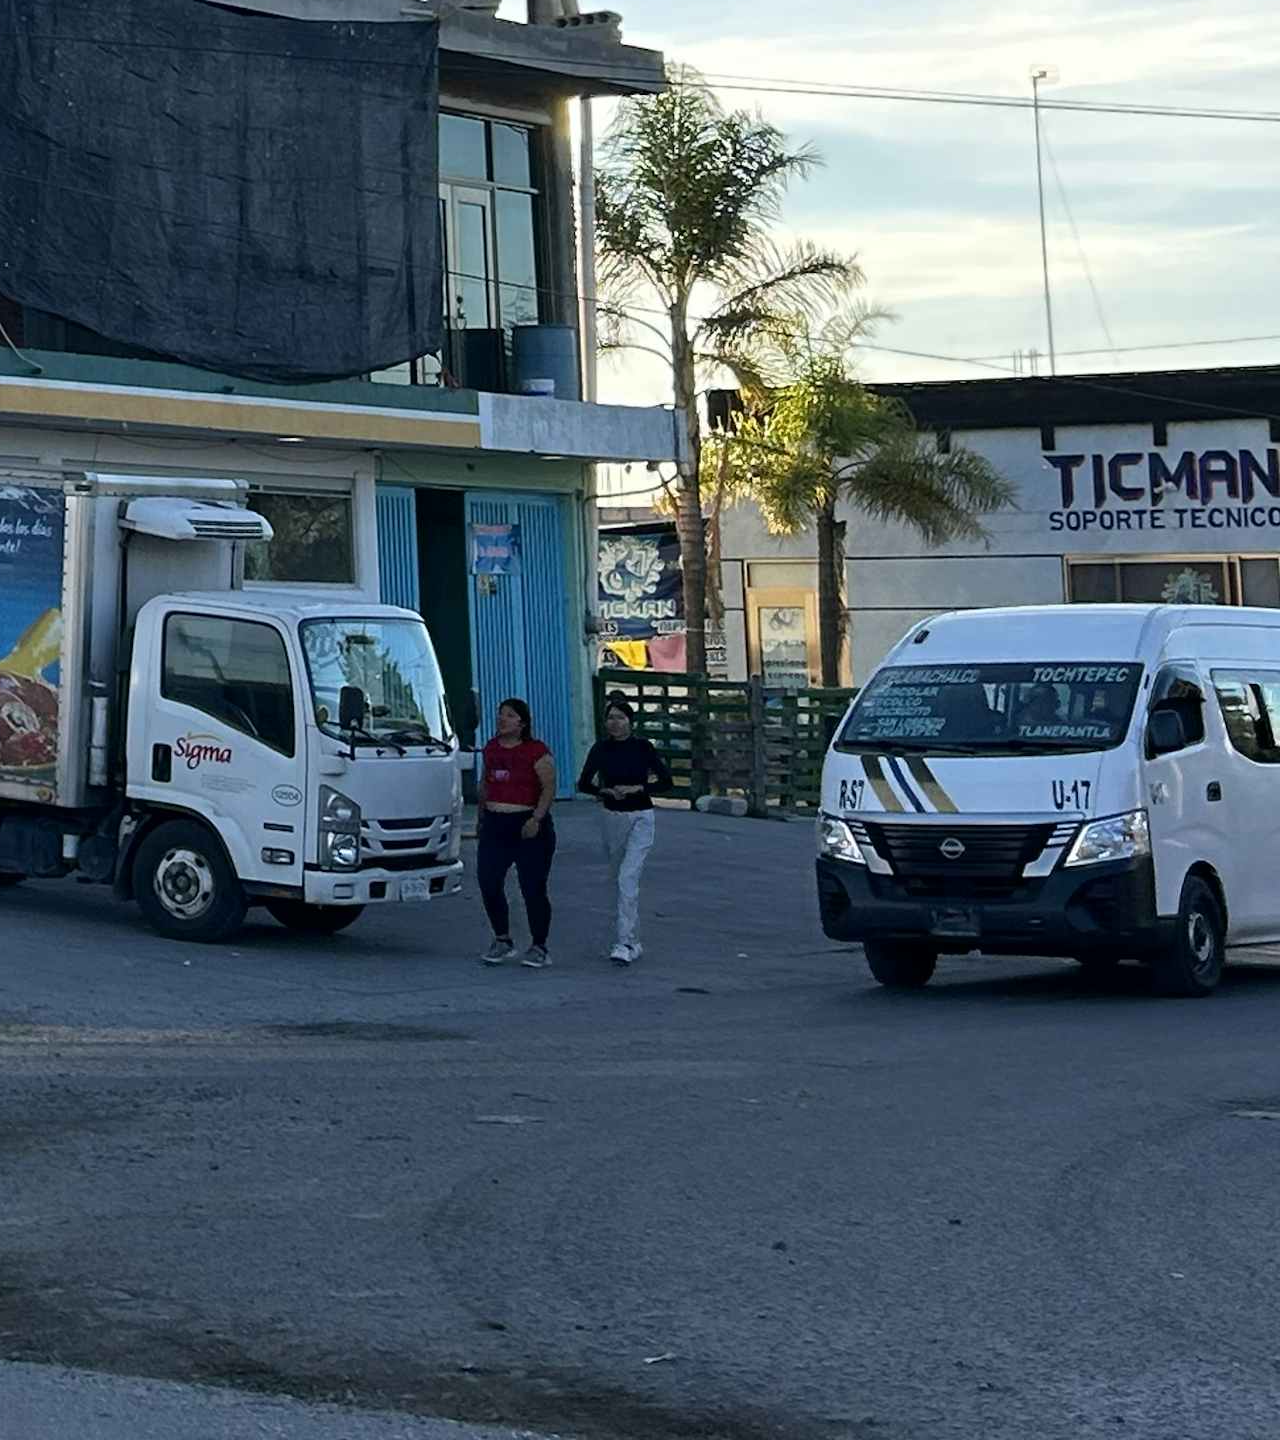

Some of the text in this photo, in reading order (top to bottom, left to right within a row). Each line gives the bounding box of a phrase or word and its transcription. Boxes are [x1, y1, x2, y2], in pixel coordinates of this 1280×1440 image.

[1042, 448, 1280, 510] TICMAN
[16, 517, 29, 536] los
[1049, 505, 1280, 532] SOPORTE TECNICO
[1032, 667, 1130, 684] TOCHTEPEC
[1018, 725, 1111, 739] TLANEPANTLA
[174, 737, 232, 770] Sigma
[1051, 779, 1091, 811] U-17
